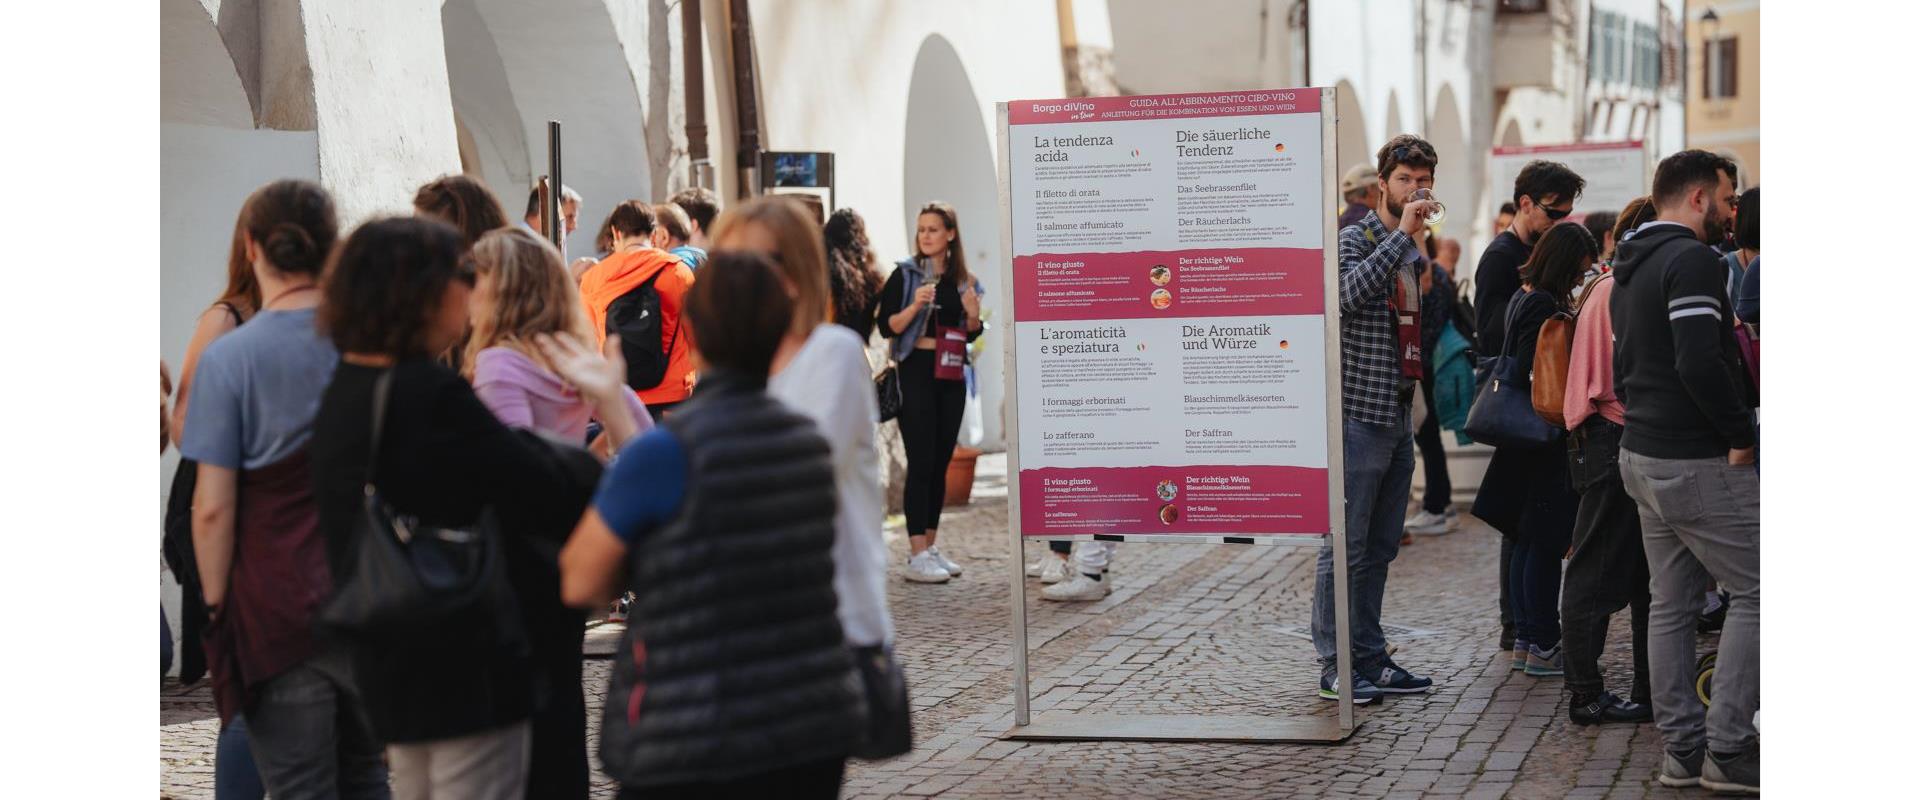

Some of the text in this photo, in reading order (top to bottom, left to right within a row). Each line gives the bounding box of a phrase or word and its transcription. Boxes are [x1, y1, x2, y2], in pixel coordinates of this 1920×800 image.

[1130, 93, 1296, 108] GUIDA ALL'ABBINAMENTO CIBO-VINO
[1033, 104, 1062, 114] Borgo
[1102, 110, 1140, 118] ANLEITUNG
[1142, 108, 1154, 116] FÜR
[1169, 106, 1218, 115] KOMBINATION
[1080, 111, 1094, 120] tour
[1176, 128, 1270, 142] Die säuerliche
[1034, 134, 1113, 148] La tendenza
[1176, 143, 1234, 157] Tendenz
[1034, 150, 1068, 162] acida
[1195, 183, 1256, 192] Seebrassenfilet
[1036, 190, 1041, 198] Il
[1043, 190, 1068, 198] filetto
[1037, 220, 1124, 230] Il salmone affumicato
[1178, 216, 1251, 226] Der Räucherlachs
[1194, 256, 1222, 265] richtige
[1040, 326, 1126, 340] L'aromaticità
[1182, 324, 1272, 337] Die Aromatik
[1041, 342, 1120, 356] e speziatura
[1183, 338, 1256, 350] und Würze
[1047, 397, 1083, 406] formaggi
[1086, 396, 1126, 405] erborinati
[1184, 394, 1285, 403] Blauschimmelkäsesorten
[1044, 431, 1094, 440] Lo zafferano
[1202, 429, 1232, 437] Saffran
[1069, 478, 1091, 486] giusto
[1201, 476, 1229, 484] richtige
